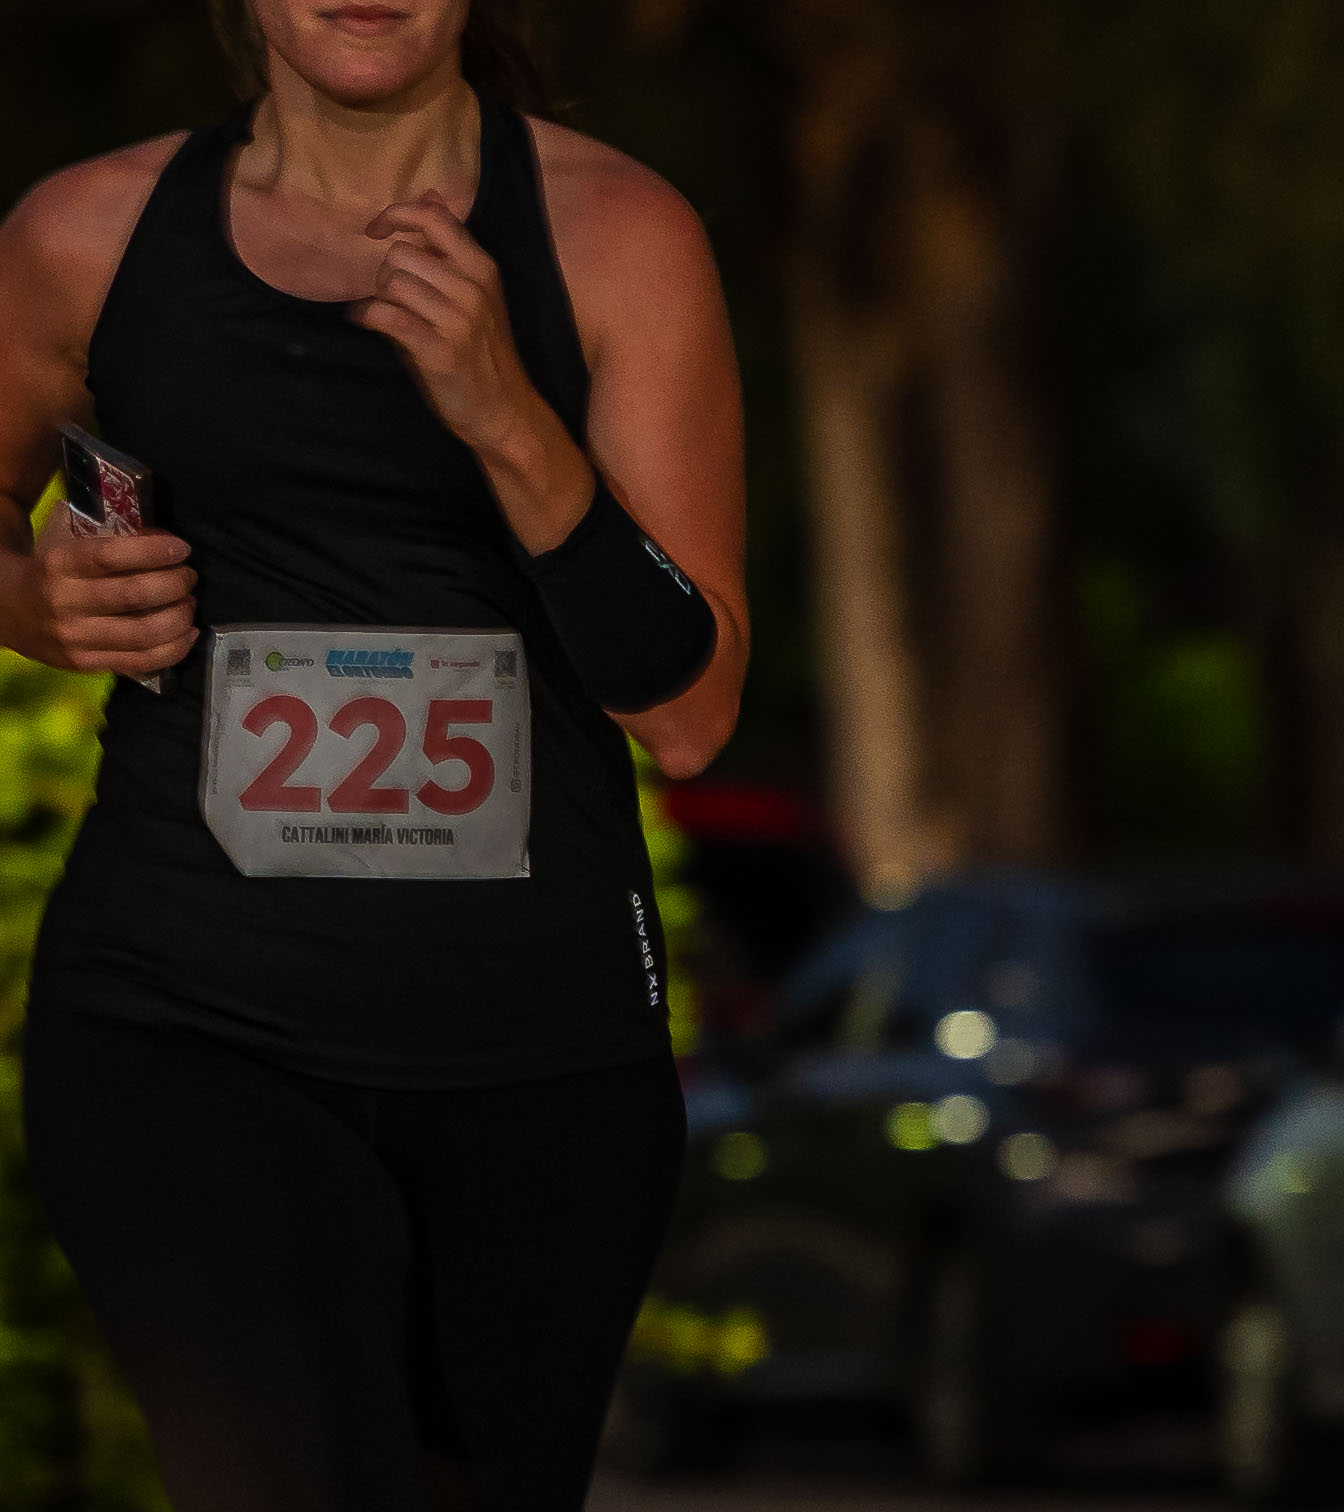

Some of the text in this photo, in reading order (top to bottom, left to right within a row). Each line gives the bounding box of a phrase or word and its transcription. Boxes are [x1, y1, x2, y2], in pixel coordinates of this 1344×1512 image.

[238, 693, 496, 816] 225
[281, 823, 455, 846] CATTALINI MARÍA VICTORIA
[632, 893, 659, 1006] NX BRAND
